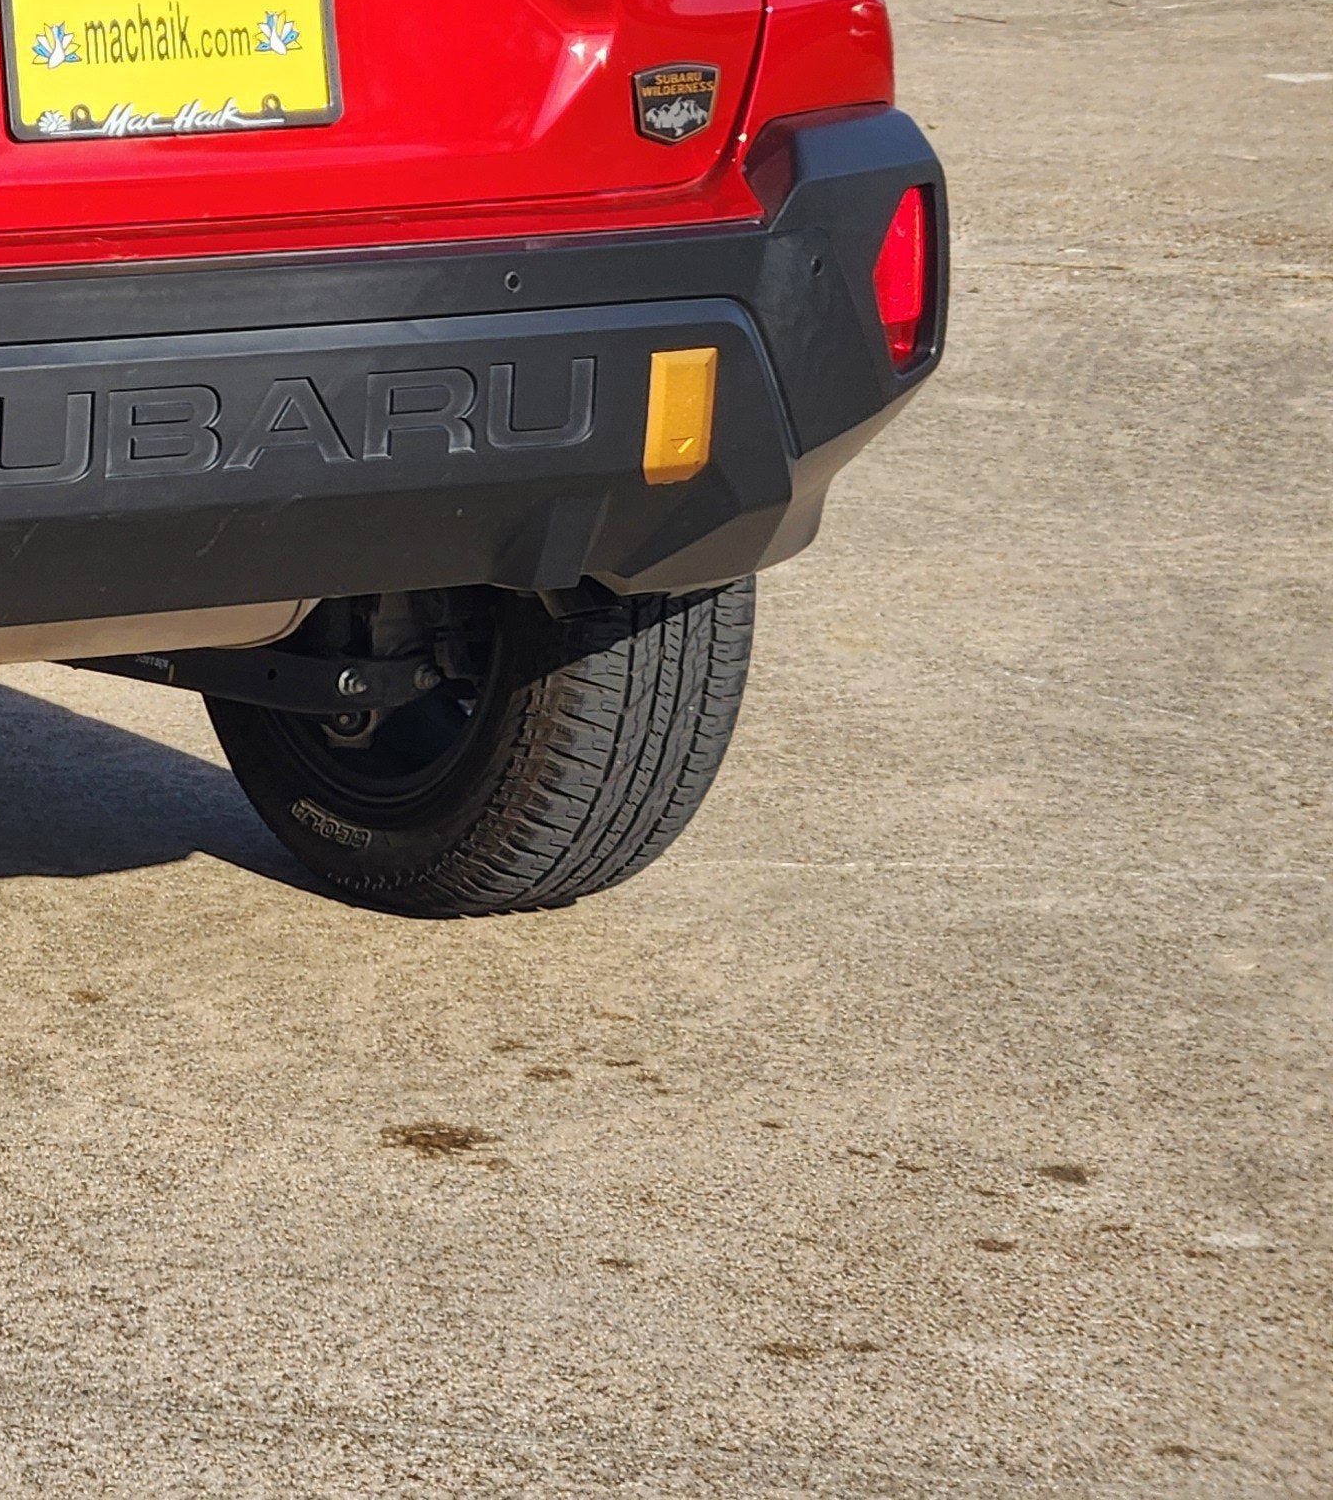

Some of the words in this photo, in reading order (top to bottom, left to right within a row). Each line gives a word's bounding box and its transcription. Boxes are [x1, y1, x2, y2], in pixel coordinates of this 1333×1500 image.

[84, 1, 251, 65] machaik.com
[641, 80, 714, 97] WILDERNESS
[655, 71, 702, 86] SUBARU
[101, 102, 171, 136] Mac
